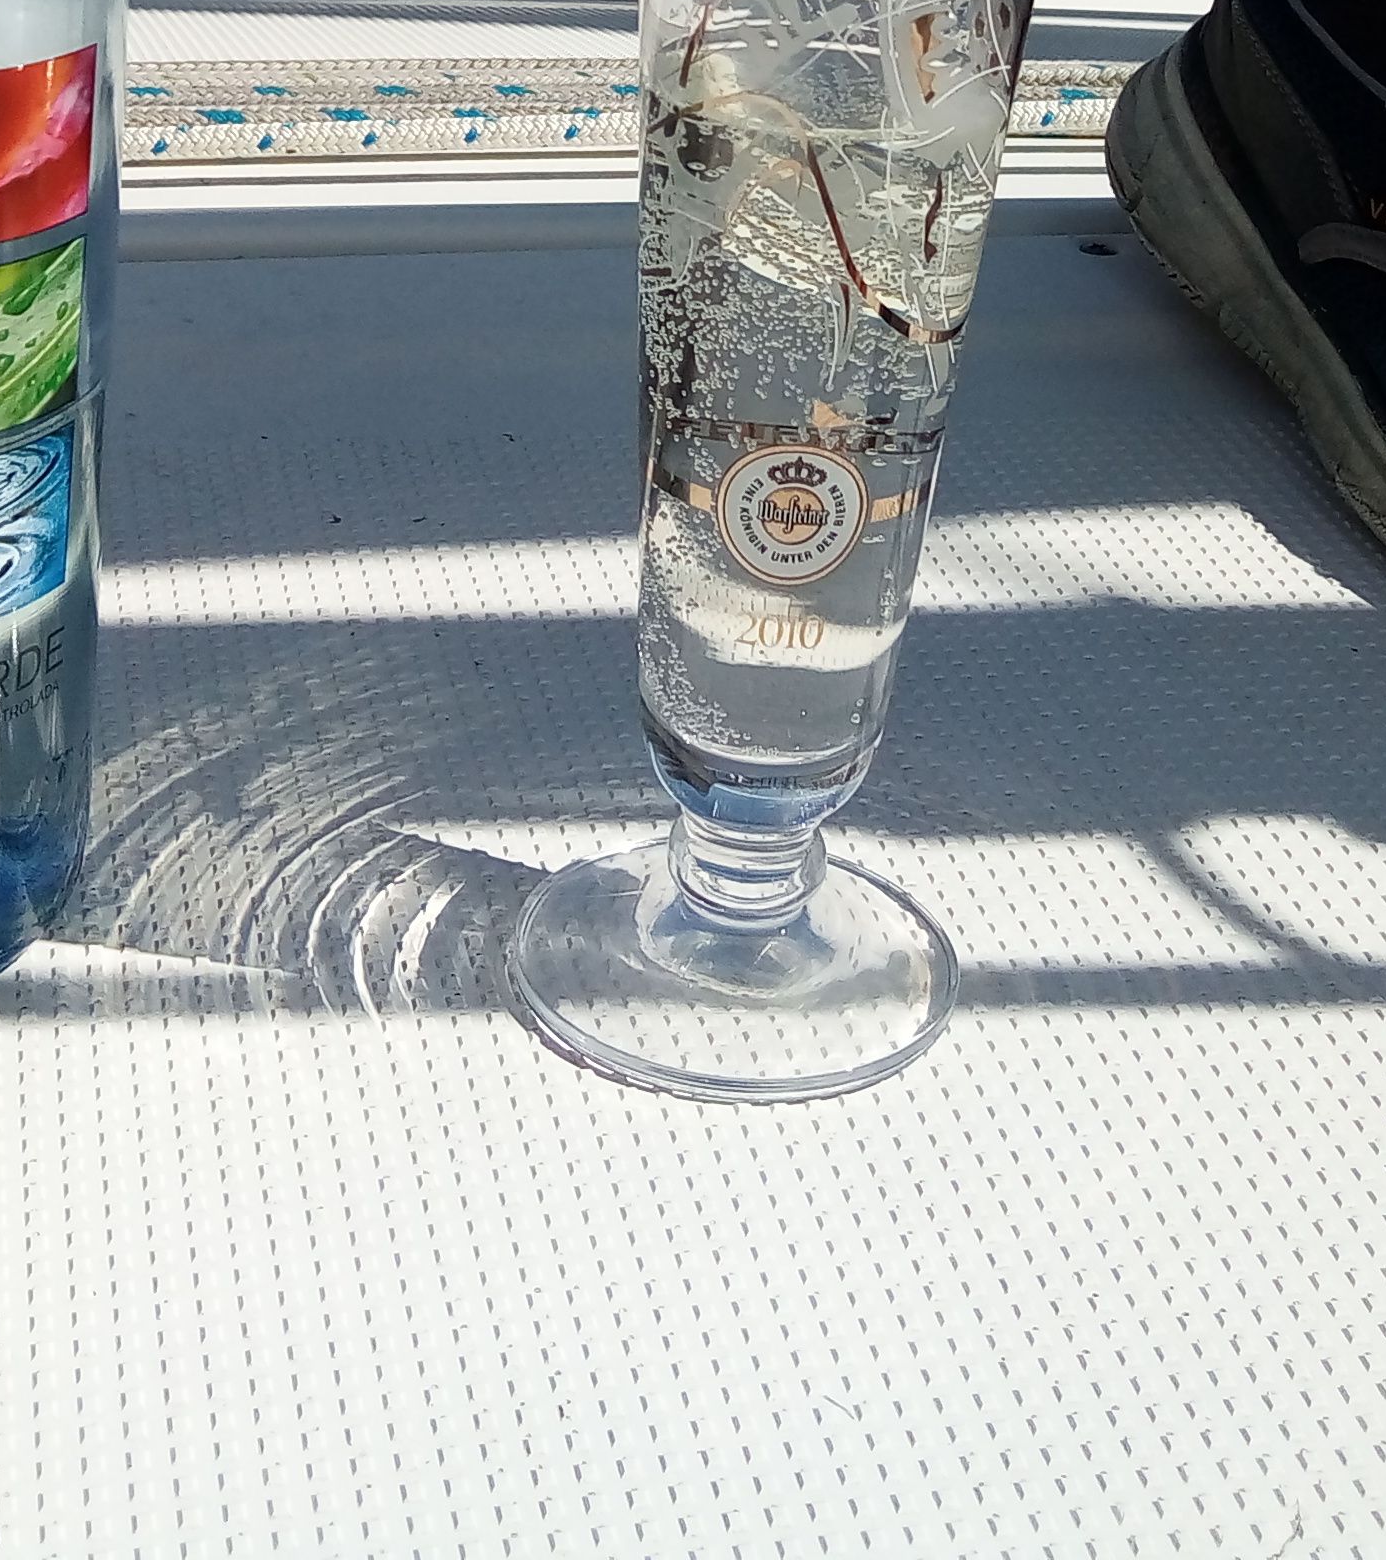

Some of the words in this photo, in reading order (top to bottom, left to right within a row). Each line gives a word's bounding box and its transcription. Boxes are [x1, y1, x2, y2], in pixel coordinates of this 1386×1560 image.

[756, 494, 830, 535] Warsteiner
[771, 550, 813, 563] UNTER
[816, 530, 838, 553] DEN
[827, 484, 846, 527] BIEREN
[734, 614, 825, 649] 2010
